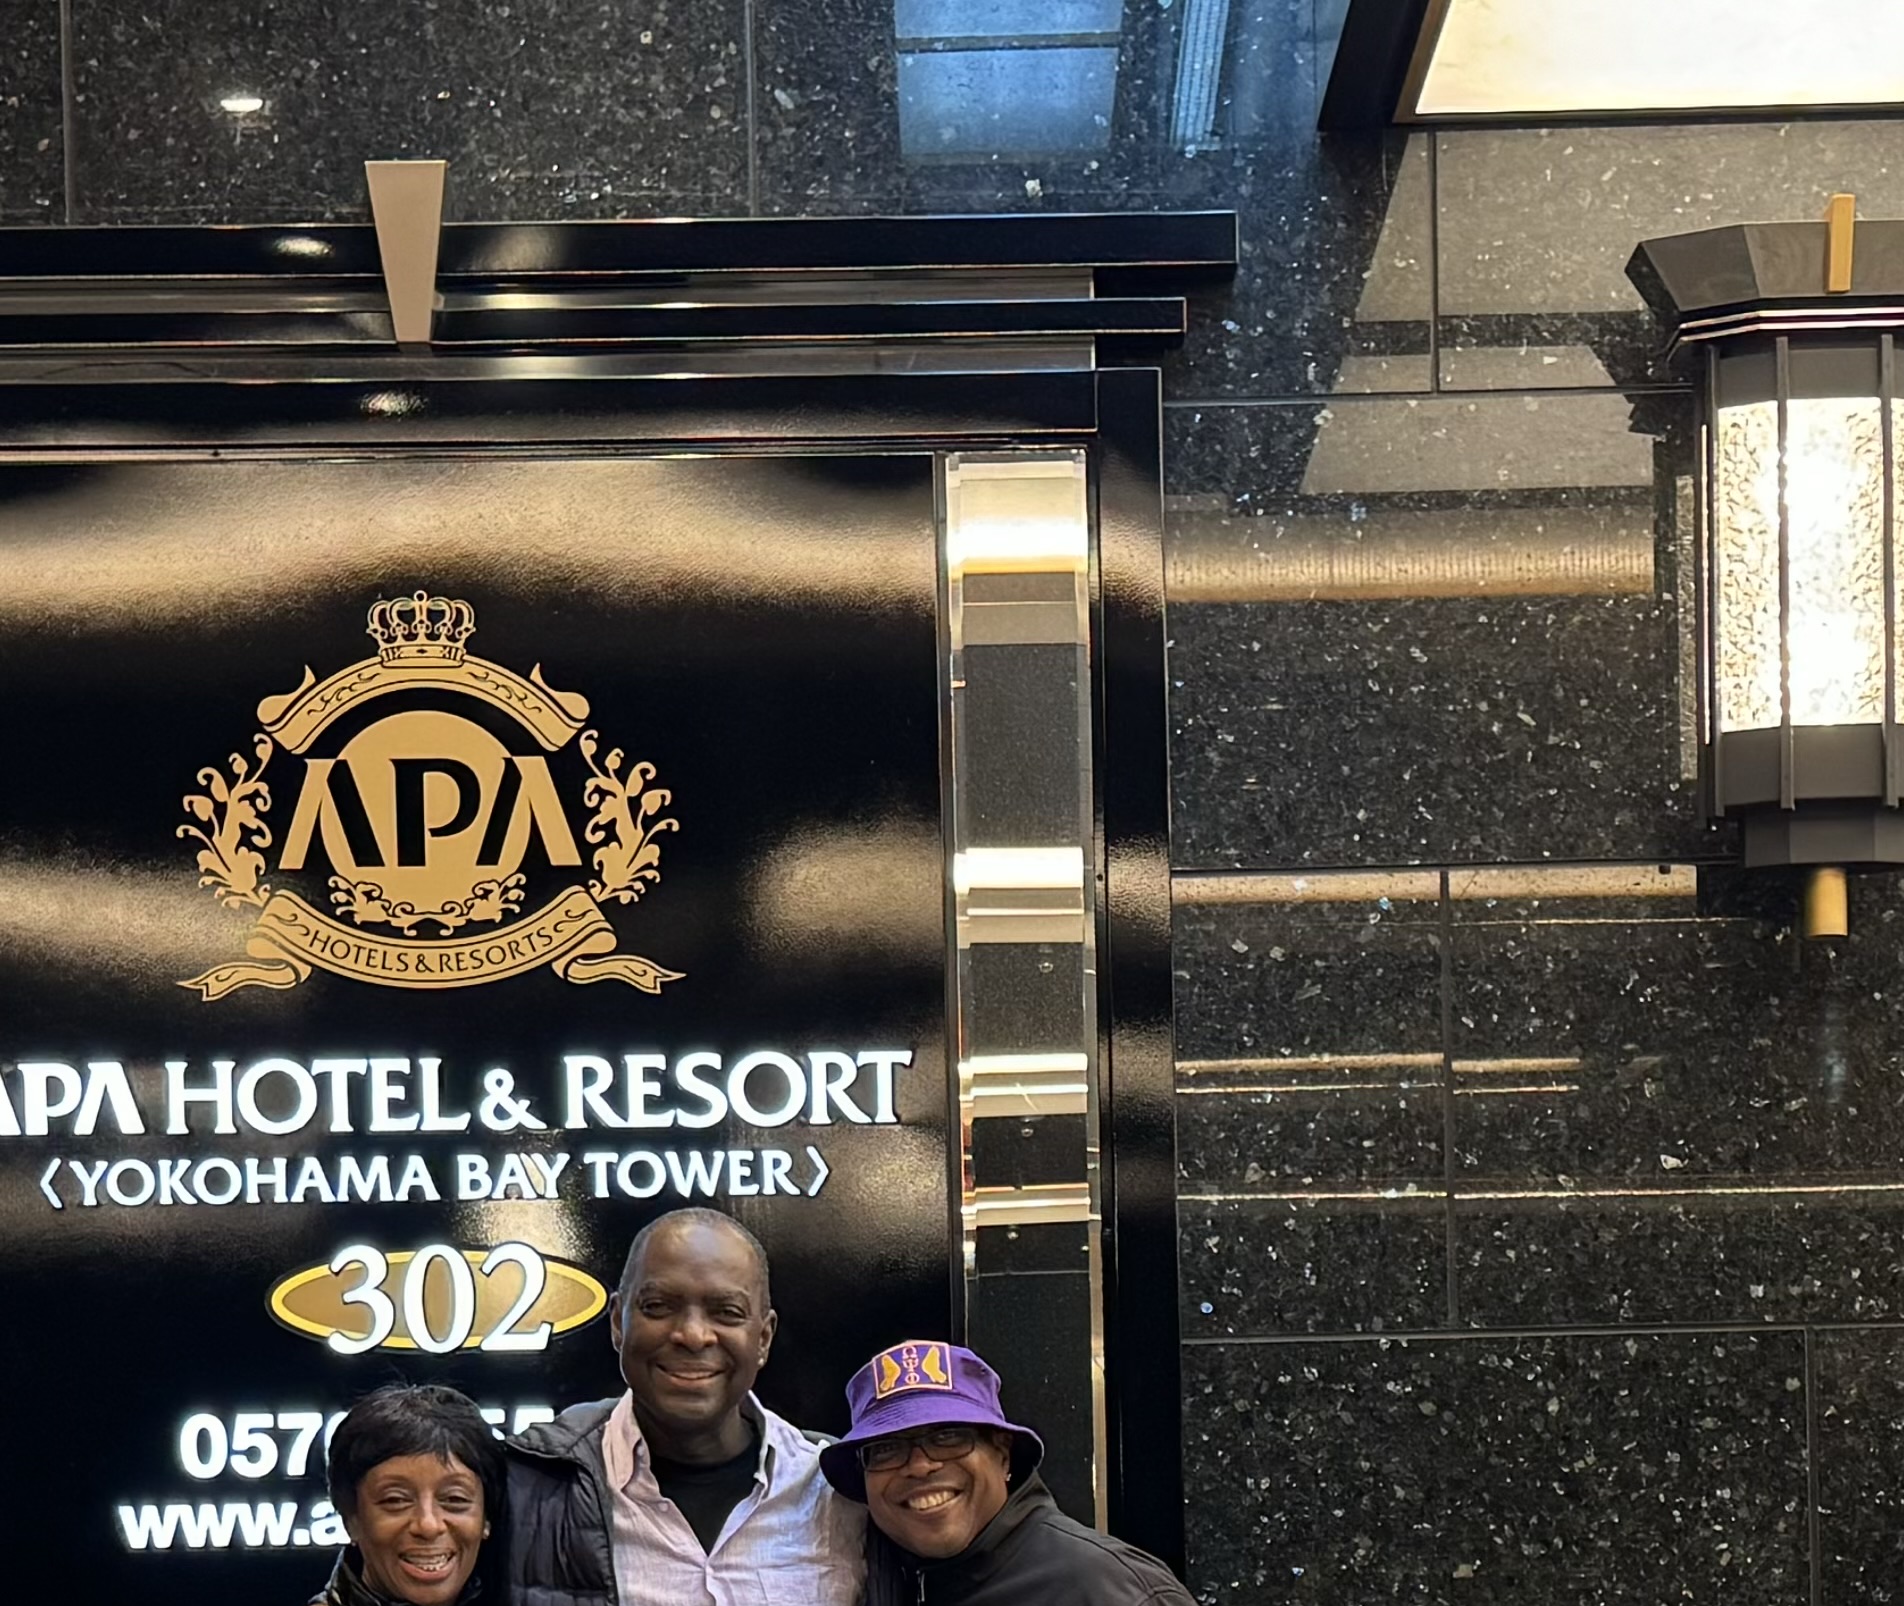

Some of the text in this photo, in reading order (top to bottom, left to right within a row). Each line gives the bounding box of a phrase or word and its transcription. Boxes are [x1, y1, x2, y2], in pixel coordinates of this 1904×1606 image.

[279, 755, 582, 870] APA
[165, 1057, 471, 1135] HOTEL
[478, 1067, 548, 1132] &
[563, 1050, 914, 1129] RESORT
[457, 1151, 571, 1201] BAY
[328, 1241, 554, 1355] 302
